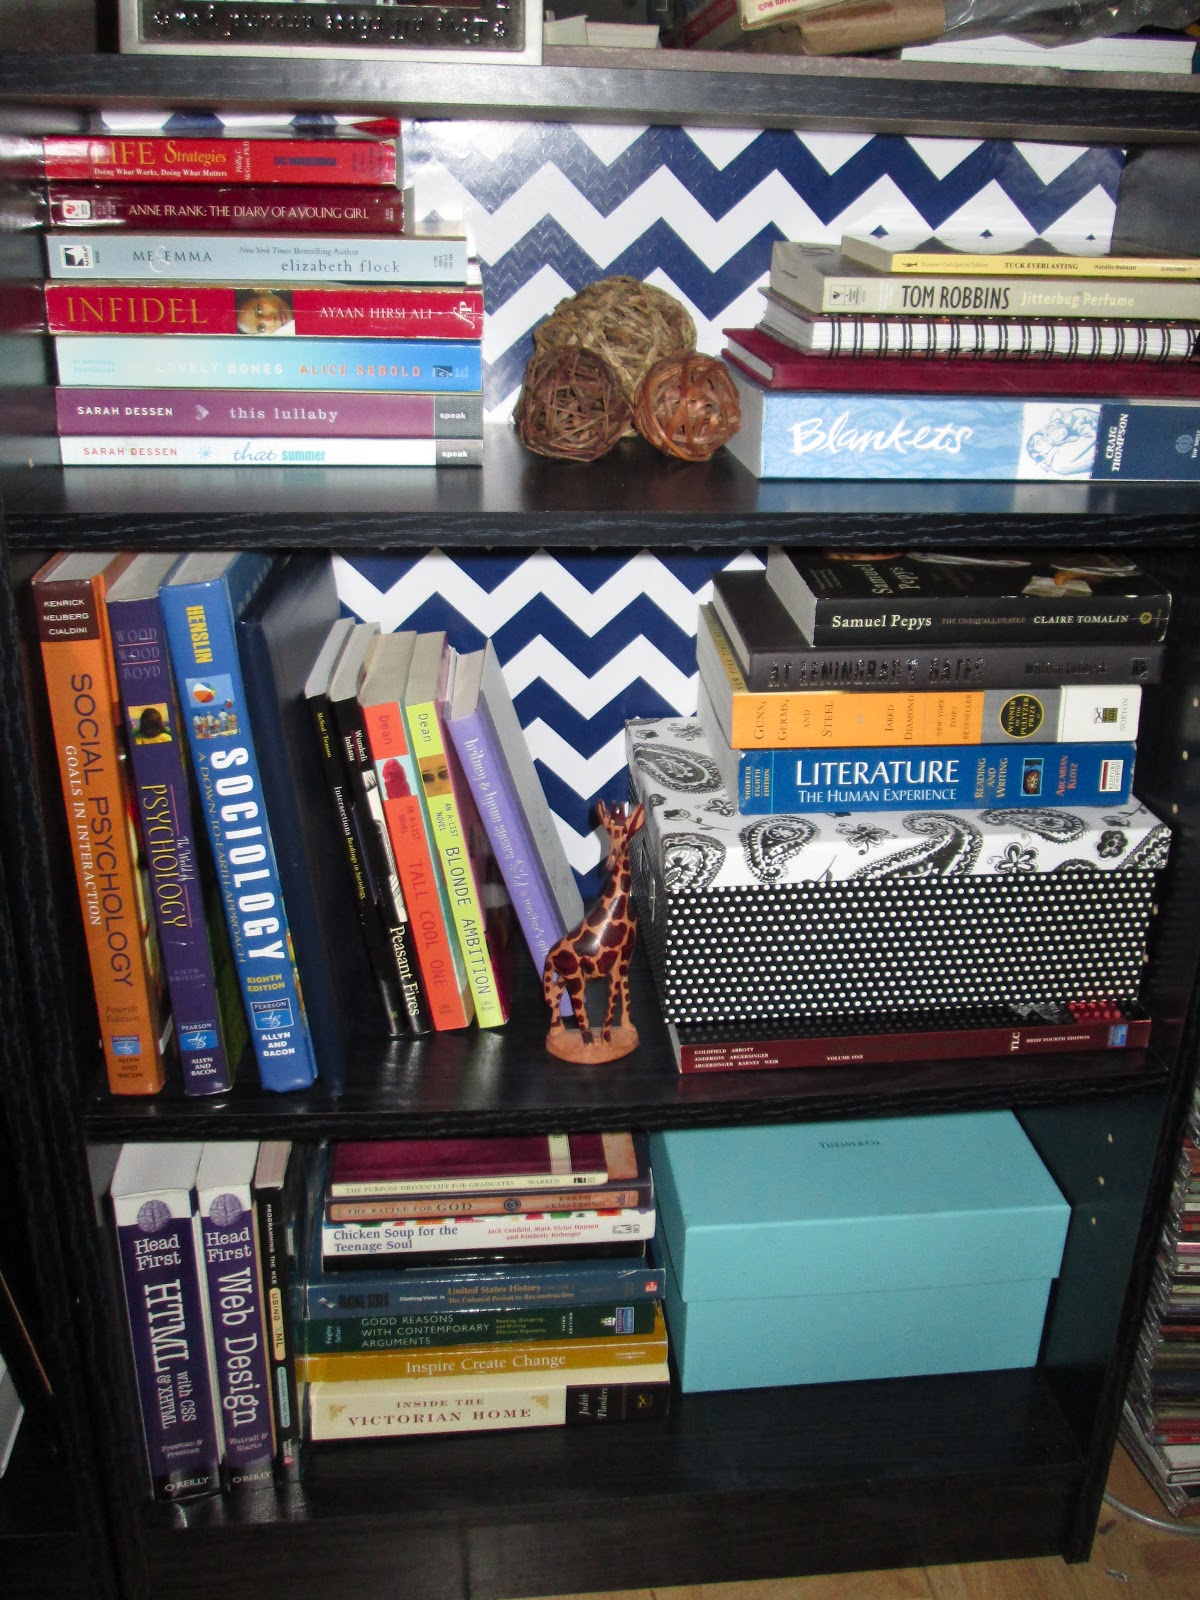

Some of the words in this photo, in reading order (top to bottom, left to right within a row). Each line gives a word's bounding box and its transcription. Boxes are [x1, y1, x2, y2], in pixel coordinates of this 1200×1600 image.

[94, 140, 156, 166] LIFE
[164, 140, 227, 166] Strategies
[94, 168, 115, 177] Doing
[116, 168, 135, 177] What
[161, 169, 182, 178] Doing
[183, 169, 201, 178] What
[202, 170, 228, 178] Matters
[129, 205, 161, 216] ANNE
[164, 205, 207, 217] FRANK:
[209, 206, 231, 217] THE
[234, 206, 270, 219] DIARY
[271, 206, 287, 218] OF
[288, 207, 300, 218] A
[299, 206, 342, 219] YOUNG
[344, 207, 370, 220] GIRL
[165, 250, 213, 262] EMMA
[294, 247, 332, 256] Bestselling
[334, 248, 359, 256] Author
[281, 260, 353, 272] elizabeth
[360, 259, 400, 273] flock
[902, 285, 935, 308] TOM
[939, 286, 1011, 310] ROBBINS
[1021, 291, 1080, 309] Jitterbug
[1083, 292, 1135, 308] Perfume
[66, 297, 208, 324] INFIDEL
[319, 307, 364, 318] AYAAN
[370, 308, 406, 319] HIRSI
[411, 308, 432, 319] ALI
[227, 363, 283, 375] BONES
[300, 364, 347, 376] ALICE
[357, 365, 422, 377] SEBOLD
[77, 406, 119, 416] SARAH
[125, 407, 173, 416] DESSEN
[230, 407, 265, 419] this
[274, 408, 338, 422] lullaby
[439, 412, 466, 420] speak
[787, 411, 974, 456] Blankets
[1105, 426, 1118, 459] CRAIG
[1111, 413, 1129, 472] THOMPSON
[83, 447, 124, 456] SARAH
[129, 447, 177, 456] DESSEN
[233, 442, 278, 461] that
[281, 450, 326, 461] summer
[441, 450, 468, 459] speak
[44, 599, 85, 608] KENRICK
[43, 612, 90, 622] NEUBERG
[832, 614, 887, 628] Samuel
[890, 614, 932, 631] Pepys
[1033, 615, 1074, 624] CLAIRE
[1077, 615, 1129, 624] TOMALIN
[48, 626, 88, 636] CIALDINI
[115, 628, 158, 643] WOOD
[186, 605, 213, 664] HENSLIN
[119, 646, 160, 661] WOOD
[803, 709, 811, 729] AND
[822, 700, 834, 737] STEEL
[885, 704, 895, 732] JARED
[904, 695, 915, 740] DIAMOND
[963, 694, 973, 740] BESTSELLER
[1008, 700, 1016, 734] WINNER
[1020, 697, 1030, 736] PULITZER
[1119, 697, 1129, 732] NORTON
[378, 715, 392, 745] Dean
[418, 713, 431, 742] Dean
[65, 745, 83, 796] GOALS
[796, 760, 960, 786] LITERATURE
[974, 757, 987, 798] READING
[987, 768, 996, 787] AND
[996, 757, 1009, 798] WRITING
[1067, 763, 1078, 789] KLOTZ
[464, 737, 486, 781] britney
[481, 790, 501, 823] lynne
[495, 821, 516, 861] spears
[798, 790, 824, 803] THE
[827, 789, 880, 802] HUMAN
[884, 788, 957, 801] EXPERIENCE
[73, 801, 87, 819] IN
[335, 786, 351, 836] Intersections
[70, 673, 104, 785] SOCIAL
[88, 796, 133, 988] PSYCHOLOGY
[436, 812, 446, 831] NOVEL
[447, 814, 458, 837] A-LIST
[141, 784, 188, 928] PSYCHOLOGY
[211, 747, 285, 959] SOCIOLOGY
[79, 823, 101, 926] INTERACTION
[409, 860, 428, 900] TALL
[419, 911, 439, 949] COOL
[430, 959, 448, 988] ONE
[445, 847, 471, 906] BLONDE
[461, 918, 491, 995] AMBITION
[247, 974, 282, 983] EIGHTH
[390, 924, 412, 980] Peasant
[404, 981, 420, 1016] Fires
[247, 982, 285, 992] EDITION
[254, 1002, 286, 1010] PEARSON
[181, 1022, 213, 1030] PEARSON
[262, 1032, 291, 1041] ALLYN
[1011, 1031, 1021, 1051] TLC
[191, 1057, 213, 1065] ALLYN
[263, 1048, 295, 1057] BACON
[190, 1068, 217, 1076] BACON
[195, 1062, 212, 1071] AND
[544, 1201, 606, 1209] ARMSTRONG
[559, 1194, 592, 1202] KAREN
[372, 1206, 408, 1214] BATTLE
[436, 1202, 473, 1212] GOD
[205, 1227, 250, 1247] Head
[266, 1203, 275, 1252] PROGRAMMING
[333, 1228, 380, 1240] Chicken
[384, 1228, 414, 1240] Soup
[418, 1226, 435, 1236] for
[439, 1225, 458, 1235] the
[488, 1227, 503, 1235] Jack
[134, 1234, 180, 1255] Head
[207, 1244, 252, 1263] First
[334, 1241, 383, 1253] Teenage
[386, 1240, 413, 1249] Soul
[136, 1251, 181, 1271] First
[218, 1266, 254, 1326] Web
[448, 1286, 478, 1296] United
[481, 1285, 506, 1293] States
[509, 1284, 541, 1294] History
[144, 1278, 189, 1373] HTML
[361, 1317, 397, 1326] GOOD
[402, 1315, 454, 1324] REASONS
[361, 1329, 392, 1337] WITH
[396, 1324, 490, 1335] CONTEMPORARY
[361, 1337, 431, 1348] ARGUMENTS
[406, 1361, 456, 1375] Inspire
[461, 1358, 507, 1369] Create
[512, 1355, 567, 1369] Change
[177, 1370, 193, 1398] with
[223, 1332, 261, 1428] Design
[158, 1385, 177, 1430] XHTML
[181, 1399, 196, 1422] CSS
[396, 1400, 449, 1409] INSIDE
[455, 1398, 485, 1406] THE
[579, 1393, 591, 1416] Judith
[598, 1387, 609, 1420] Flanders
[348, 1411, 462, 1427] VICTORIAN
[473, 1408, 531, 1420] HOME
